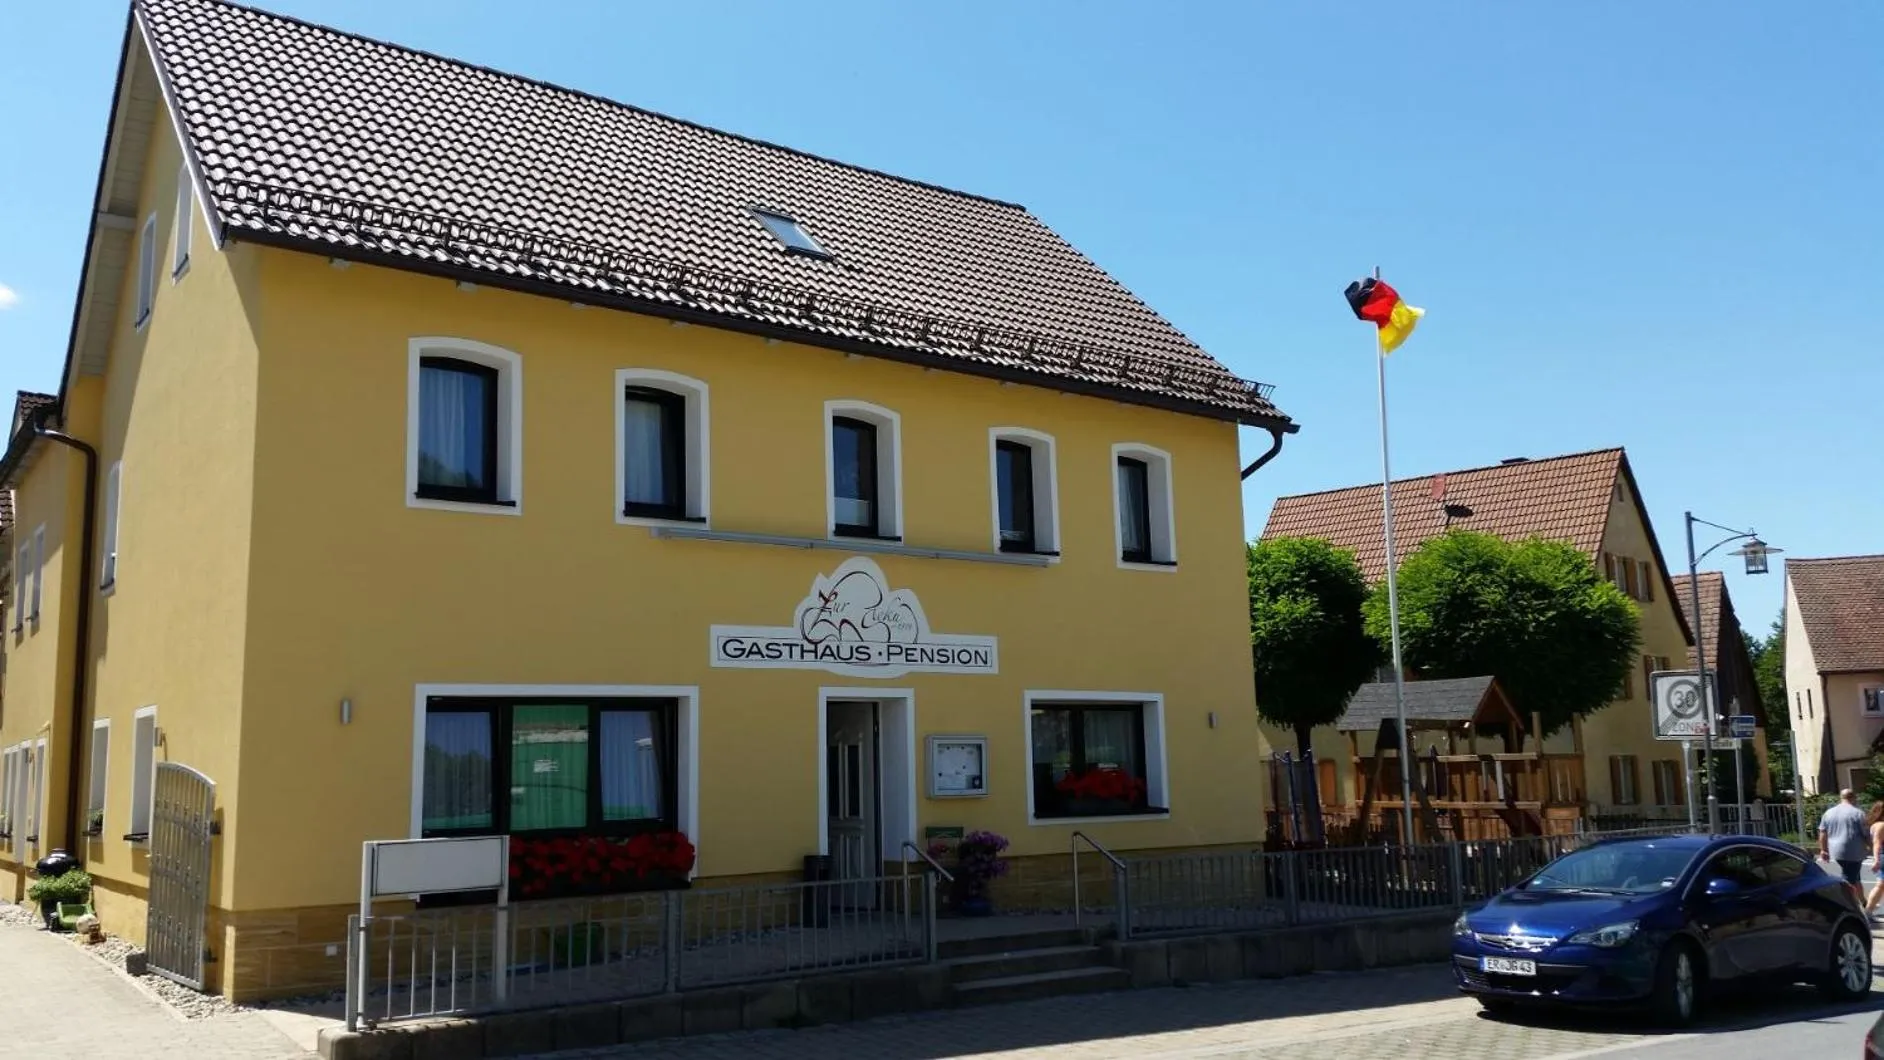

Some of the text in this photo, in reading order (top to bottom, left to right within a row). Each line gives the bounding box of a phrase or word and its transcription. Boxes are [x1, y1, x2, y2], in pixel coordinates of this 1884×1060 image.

[721, 638, 989, 665] GASTHAUS PENSION
[1673, 690, 1696, 709] 30
